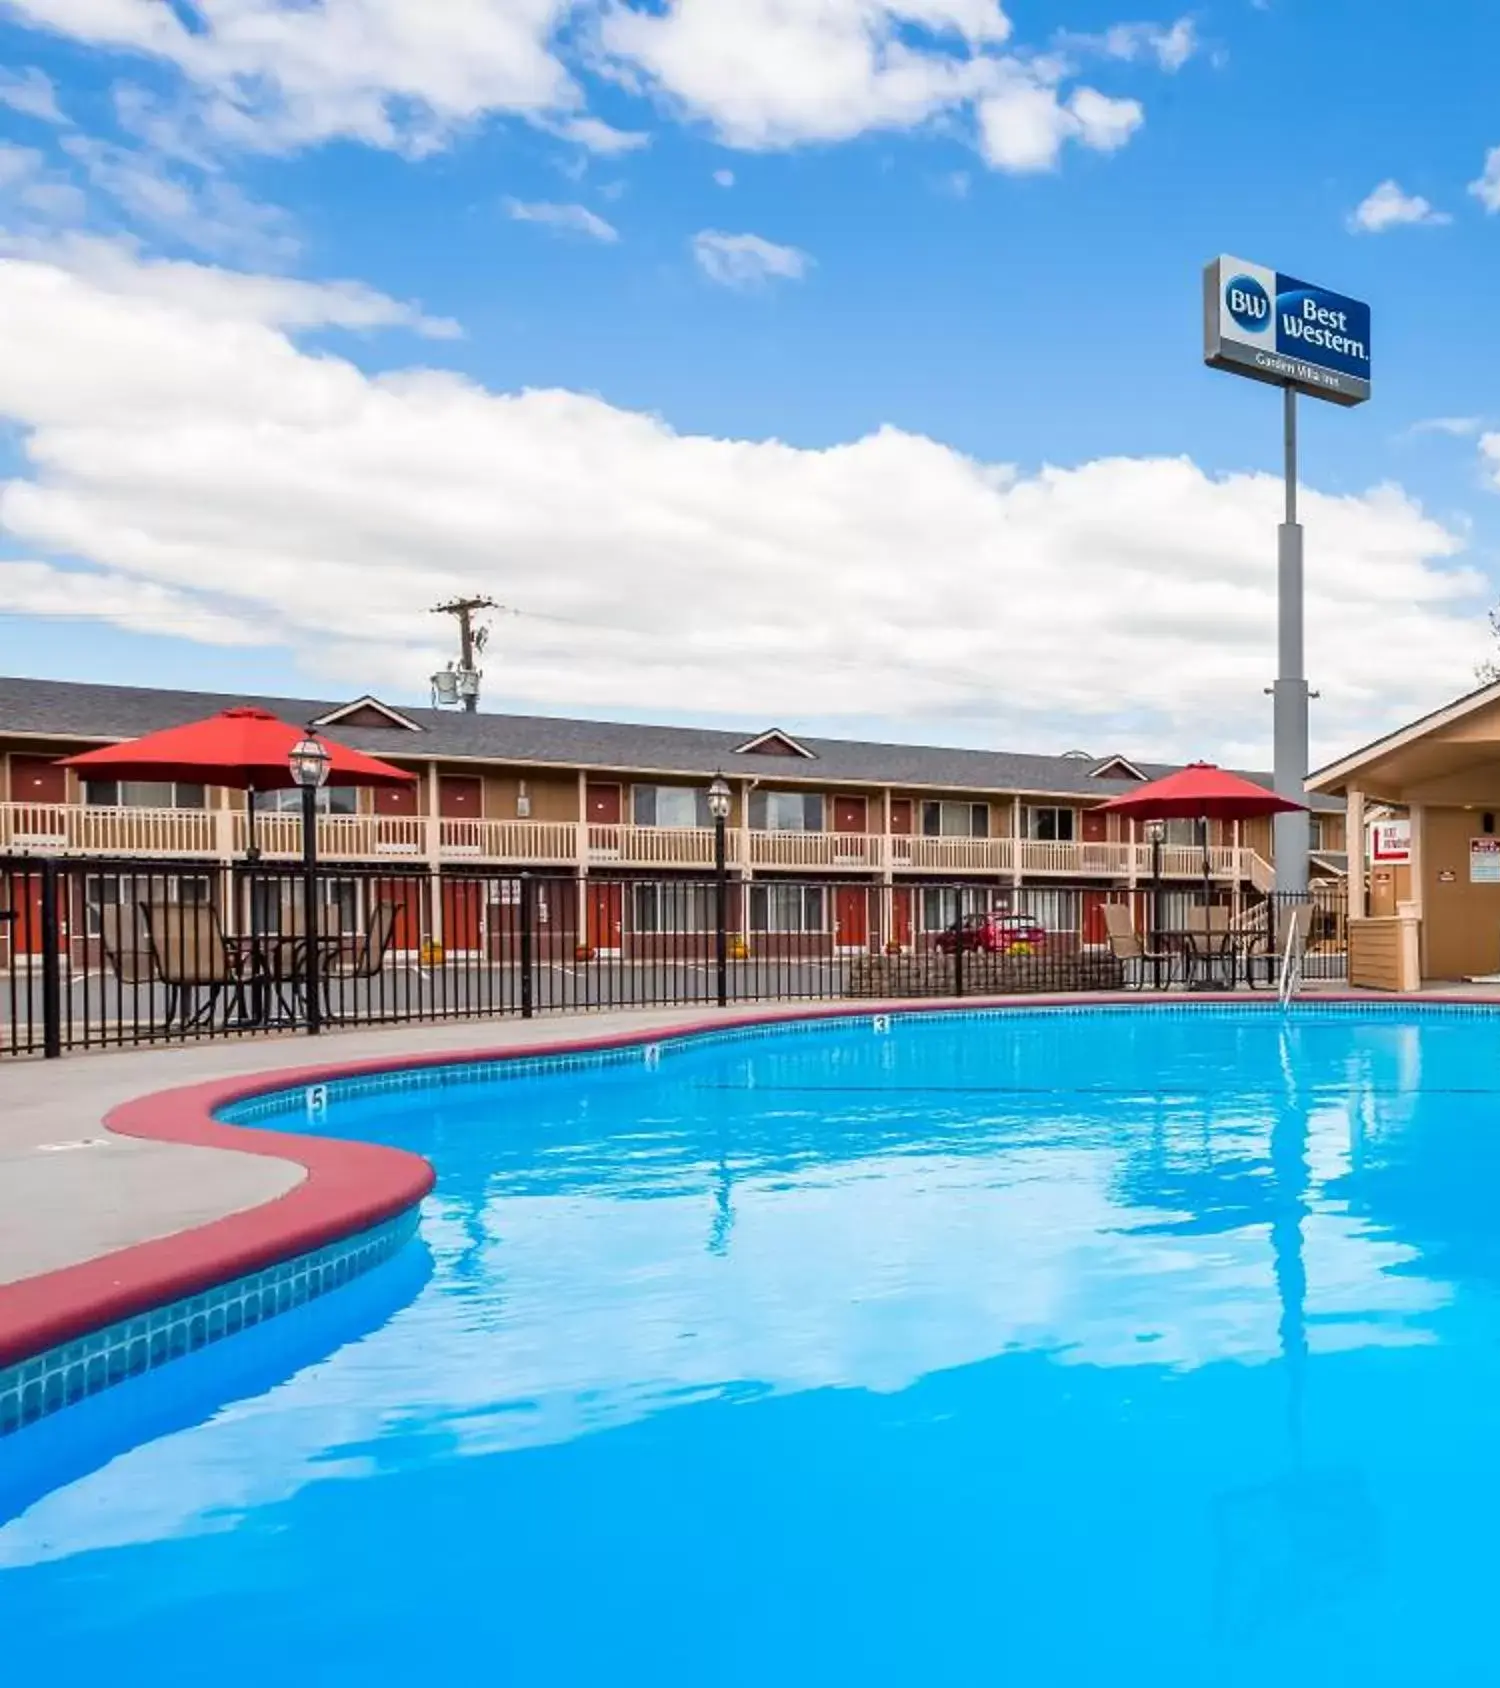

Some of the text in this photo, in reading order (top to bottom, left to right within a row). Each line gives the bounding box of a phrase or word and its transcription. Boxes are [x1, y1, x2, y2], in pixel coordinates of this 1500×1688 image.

[1231, 289, 1267, 319] BW
[1303, 298, 1347, 332] Best
[1255, 352, 1295, 375] Garden
[312, 1087, 323, 1112] 5
